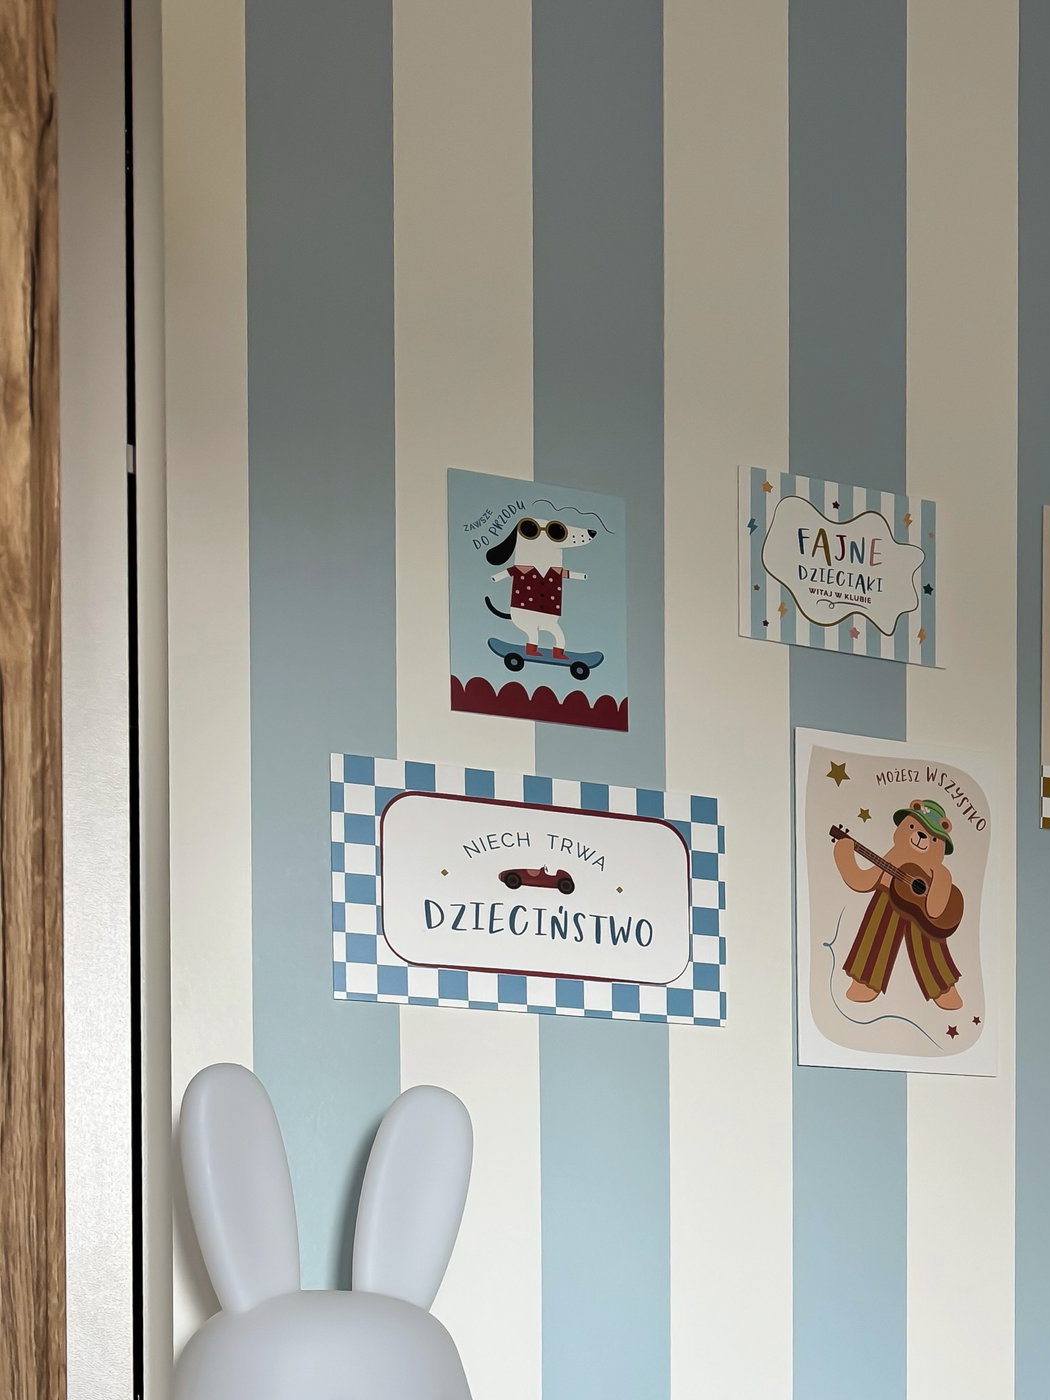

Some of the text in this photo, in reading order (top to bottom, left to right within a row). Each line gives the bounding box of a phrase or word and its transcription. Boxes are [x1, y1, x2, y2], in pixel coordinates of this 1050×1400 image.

[463, 508, 493, 532] ZAWSZE
[472, 500, 526, 550] DO PRZODU
[797, 528, 883, 567] FAJNE
[798, 565, 883, 594] DZIECIAKI
[808, 587, 872, 604] WITAJ W KLUBIE
[876, 766, 987, 832] MOŻESZ WSZYSTKO
[462, 832, 606, 872] NIECH TRWA
[424, 899, 653, 948] DZIECIŃSTWO
